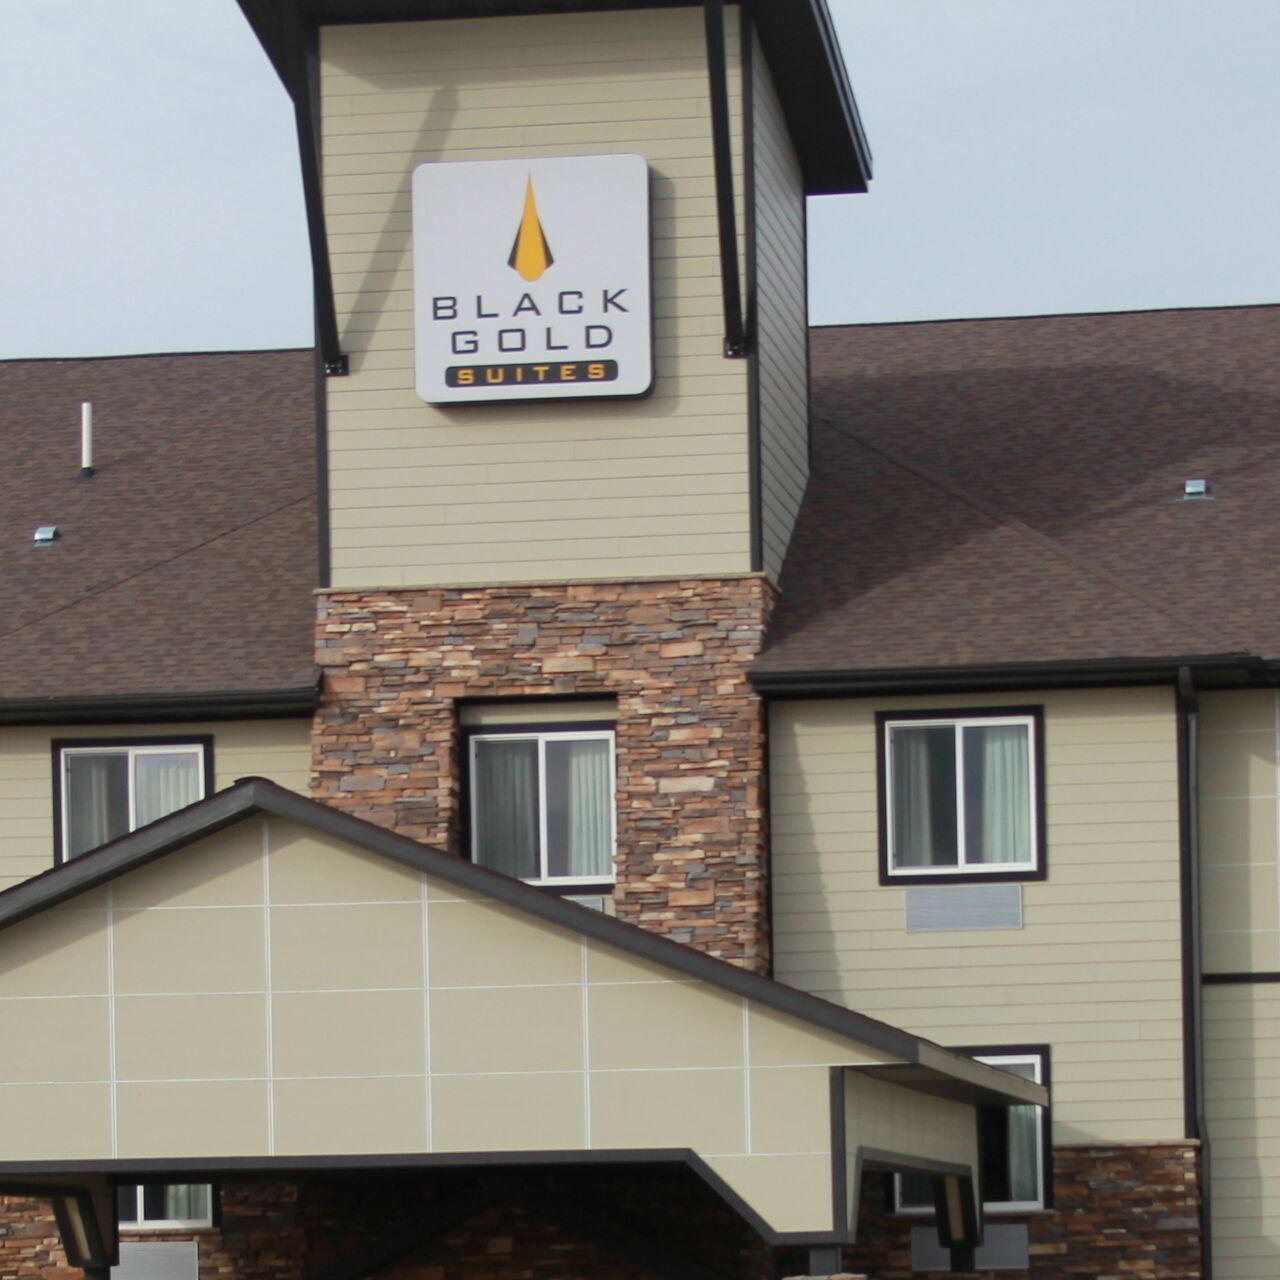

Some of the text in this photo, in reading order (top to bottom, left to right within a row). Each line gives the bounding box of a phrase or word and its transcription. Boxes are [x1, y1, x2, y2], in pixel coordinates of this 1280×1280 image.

[432, 289, 629, 320] BLACK
[451, 325, 613, 354] GOLD
[456, 364, 605, 384] SUITES
